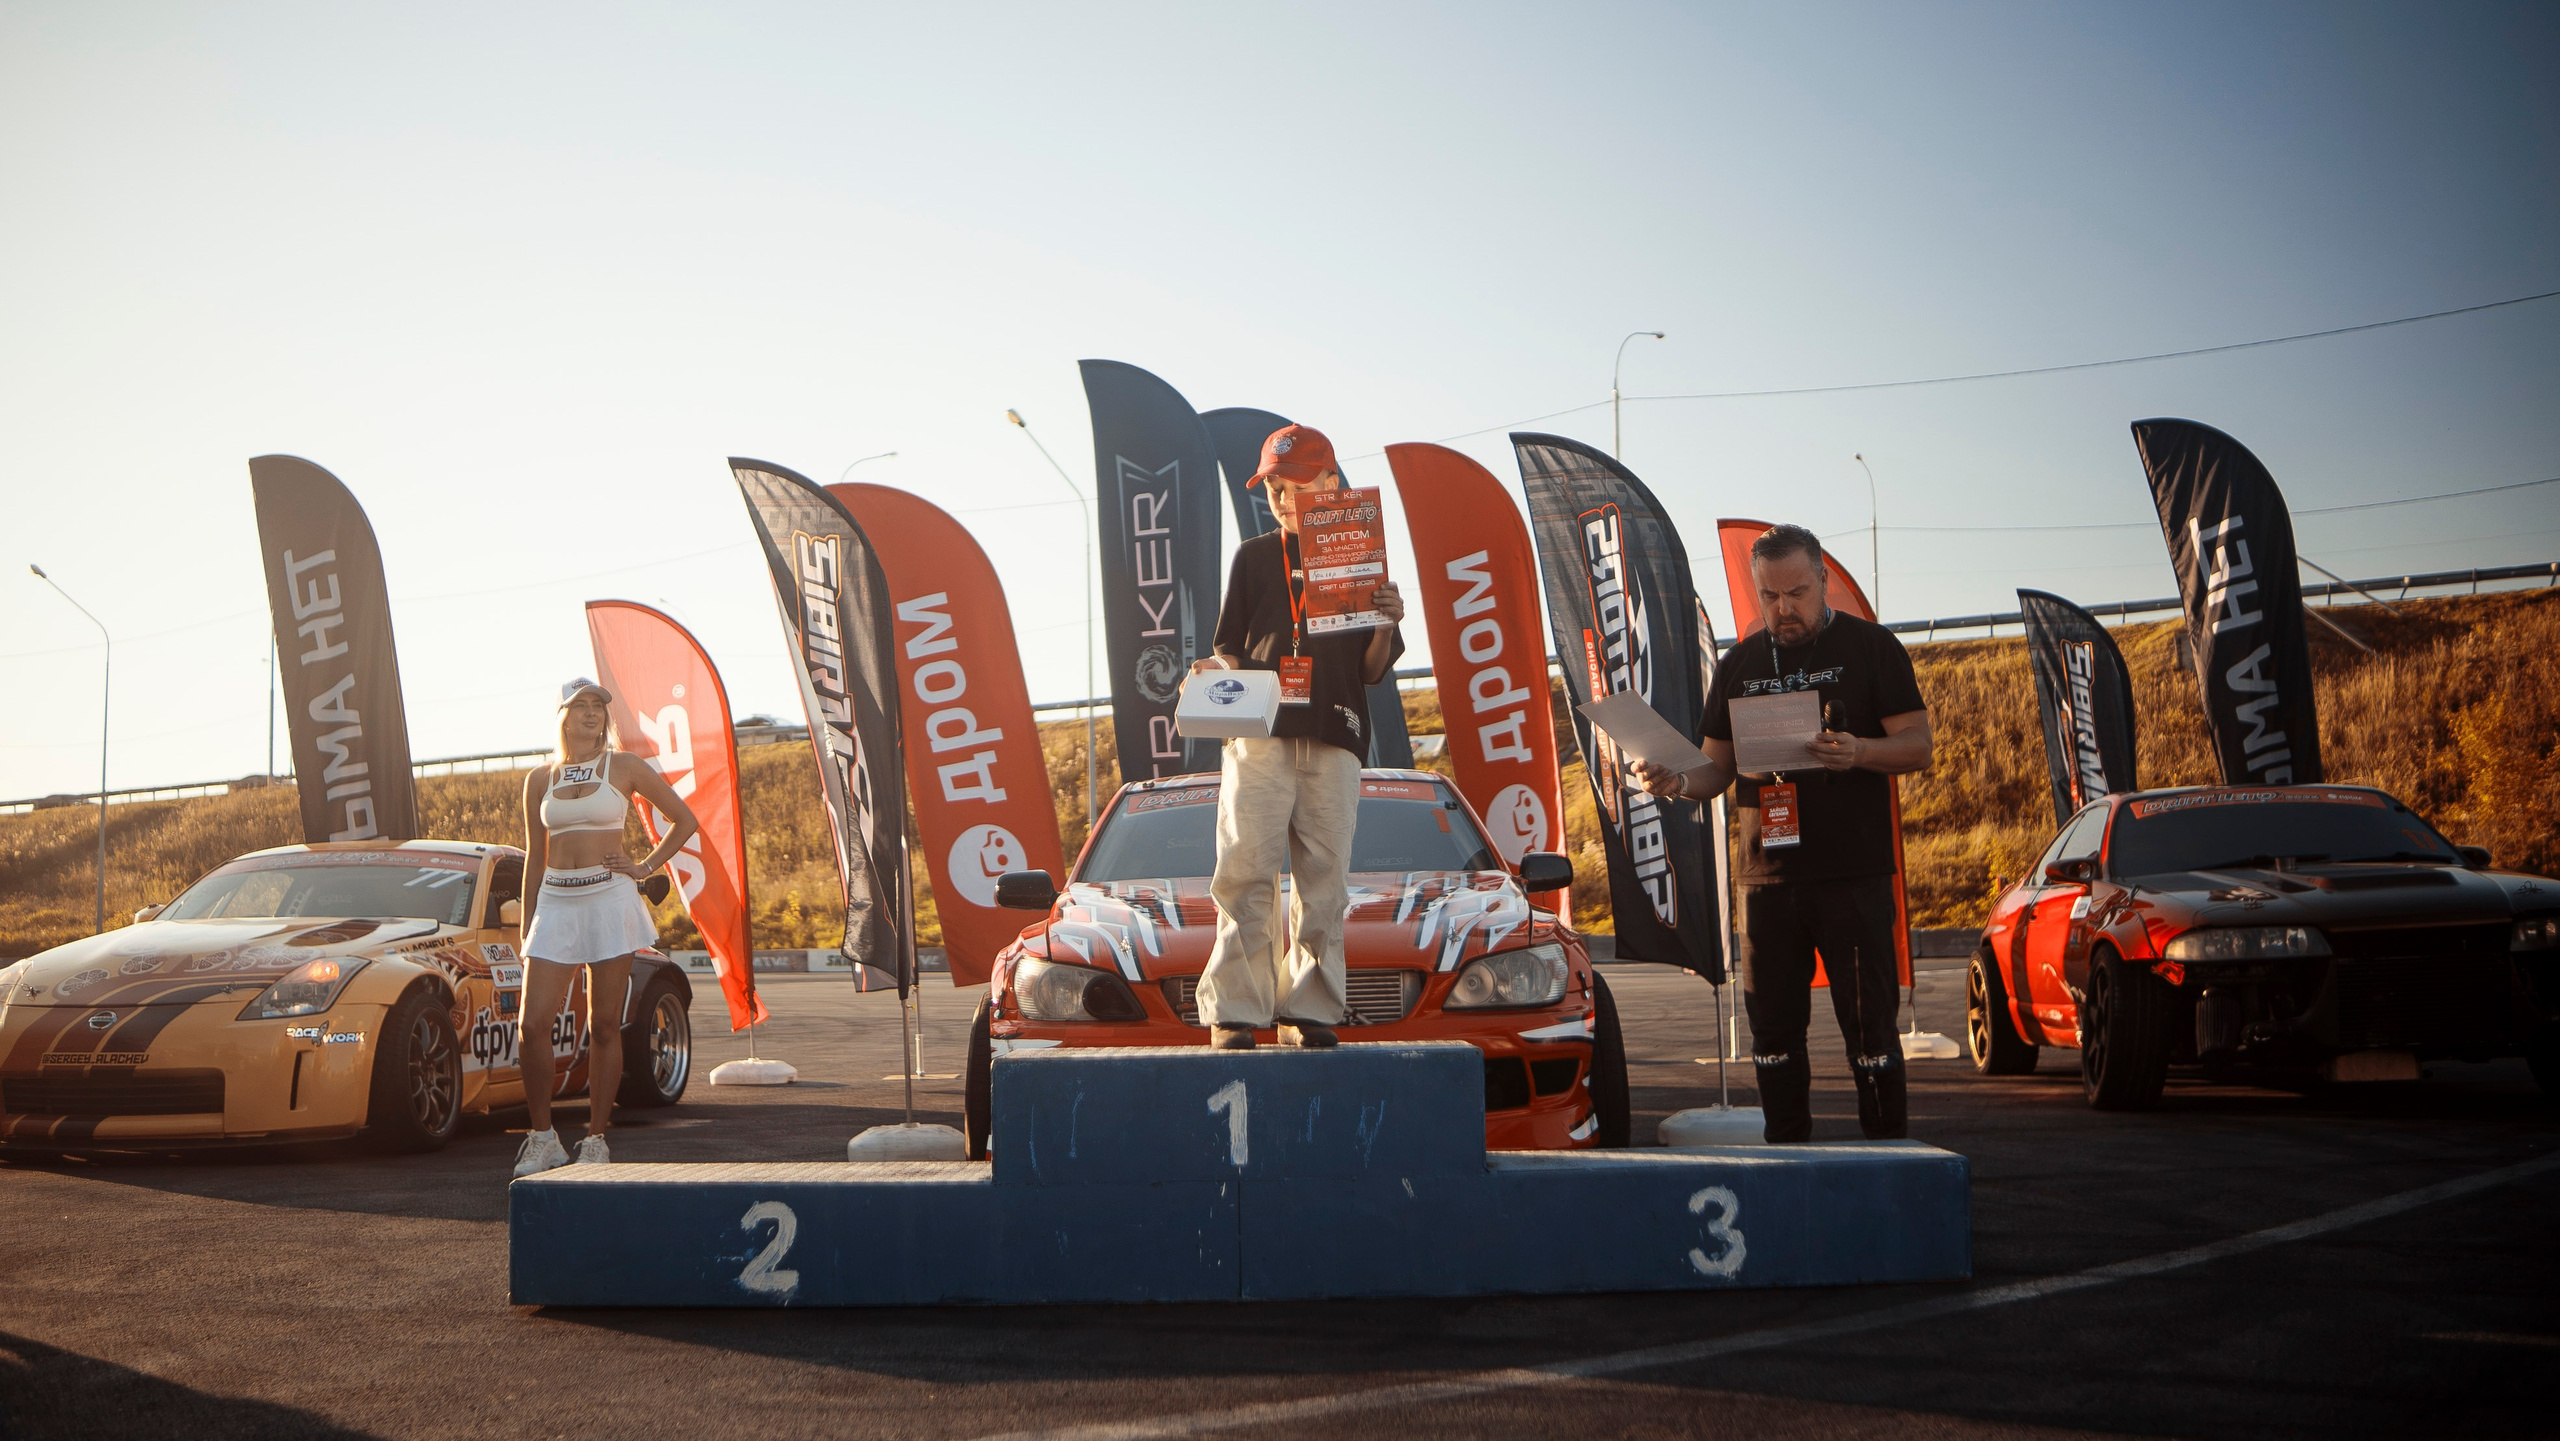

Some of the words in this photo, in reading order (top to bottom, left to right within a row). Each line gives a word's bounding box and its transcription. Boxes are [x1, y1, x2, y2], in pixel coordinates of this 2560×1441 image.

[1303, 509, 1344, 526] DRIFT
[1344, 506, 1378, 523] LETO
[1316, 529, 1370, 544] ДИПЛОМ
[2188, 514, 2264, 635] НЕТ
[284, 549, 349, 666] НЕТ
[1446, 549, 1533, 763] дром
[896, 591, 1008, 804] дром
[308, 673, 389, 842] ЫМА
[564, 766, 593, 782] SM
[1379, 785, 1410, 794] дром
[1430, 808, 1453, 833] 1
[402, 867, 470, 889] 77
[42, 1053, 150, 1065] @SERGEY_ALACHEV
[285, 1026, 319, 1039] RACE
[322, 1031, 367, 1044] WORK
[1207, 1078, 1250, 1167] 1
[740, 1202, 799, 1293] 2
[1688, 1186, 1747, 1279] 3
